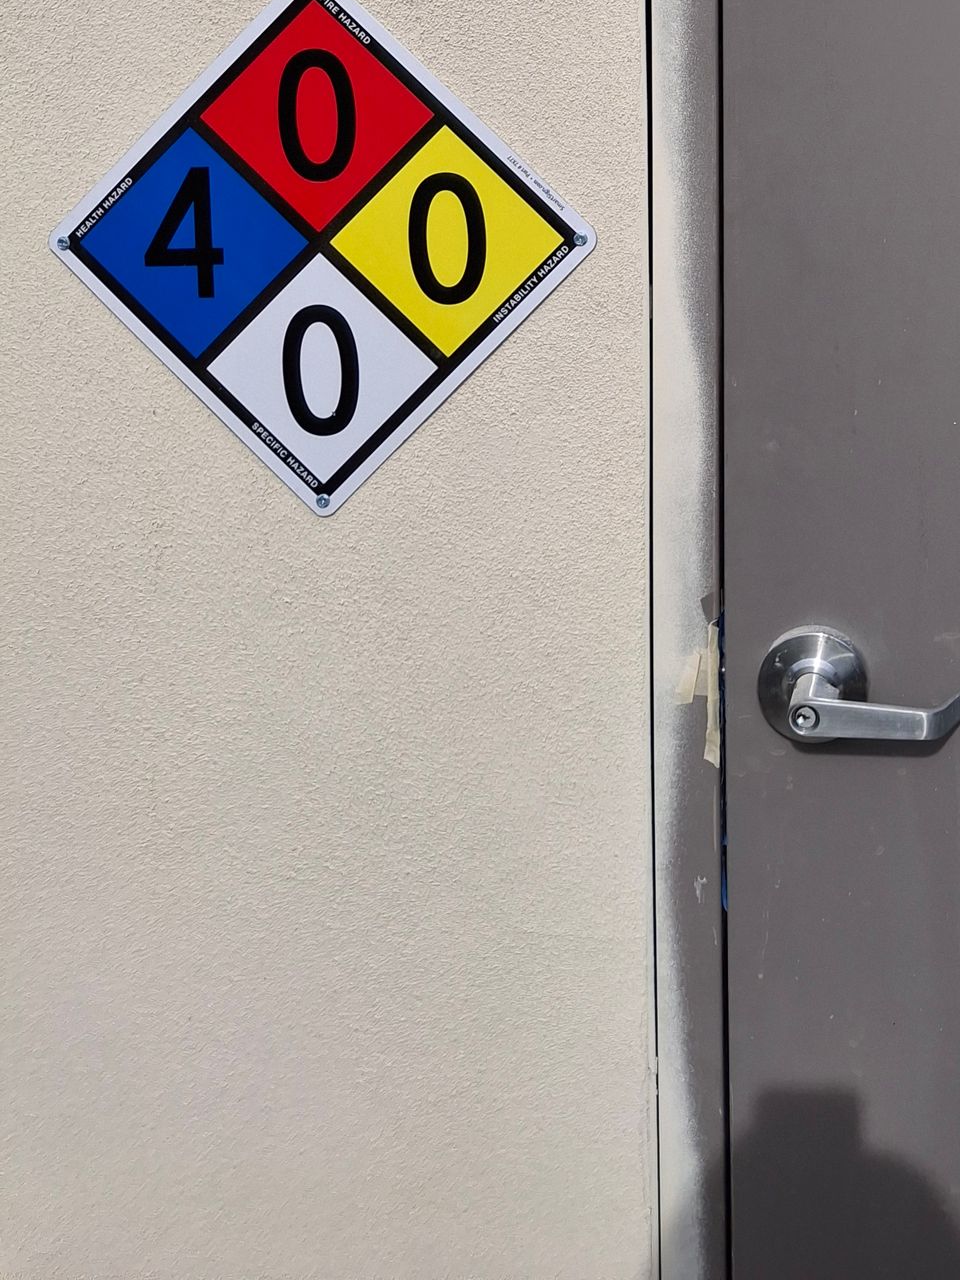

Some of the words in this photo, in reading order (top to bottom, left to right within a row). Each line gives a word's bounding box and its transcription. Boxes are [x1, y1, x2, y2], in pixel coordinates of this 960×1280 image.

[338, 12, 371, 45] HAZARD
[277, 48, 357, 182] 0
[75, 207, 105, 238] HEALTH
[102, 177, 133, 209] HAZARD
[144, 166, 224, 298] 4
[533, 179, 566, 211] SmartSign.com
[407, 171, 487, 306] 0
[492, 275, 539, 323] INSTABILITY
[537, 245, 569, 278] HAZARD
[281, 303, 360, 437] 0
[251, 422, 288, 458] SPECIFIC
[286, 456, 318, 488] HAZARD
